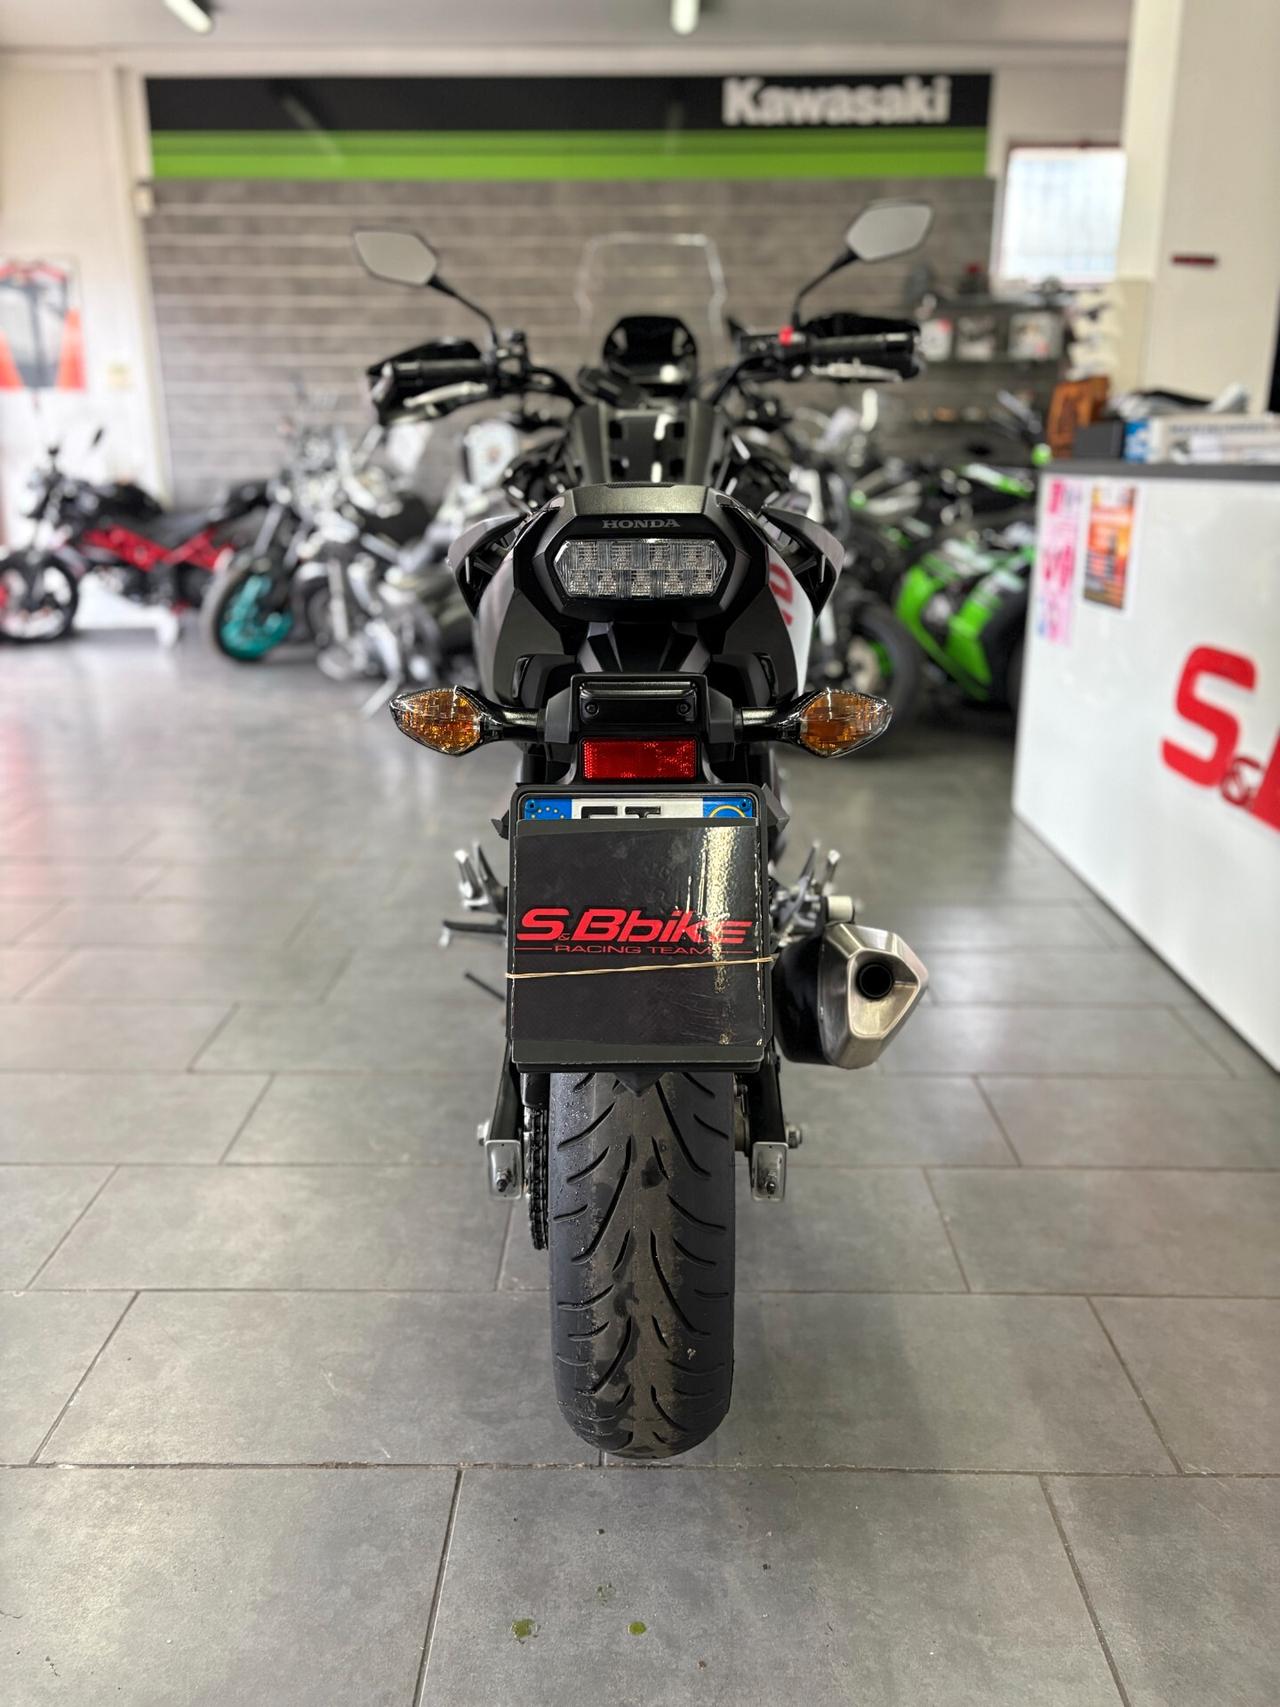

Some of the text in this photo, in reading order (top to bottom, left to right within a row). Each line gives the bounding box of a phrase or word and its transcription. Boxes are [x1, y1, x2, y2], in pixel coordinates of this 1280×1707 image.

[722, 76, 951, 126] Kawasaki
[602, 519, 680, 529] HONDA
[554, 945, 712, 955] RACING TEAM
